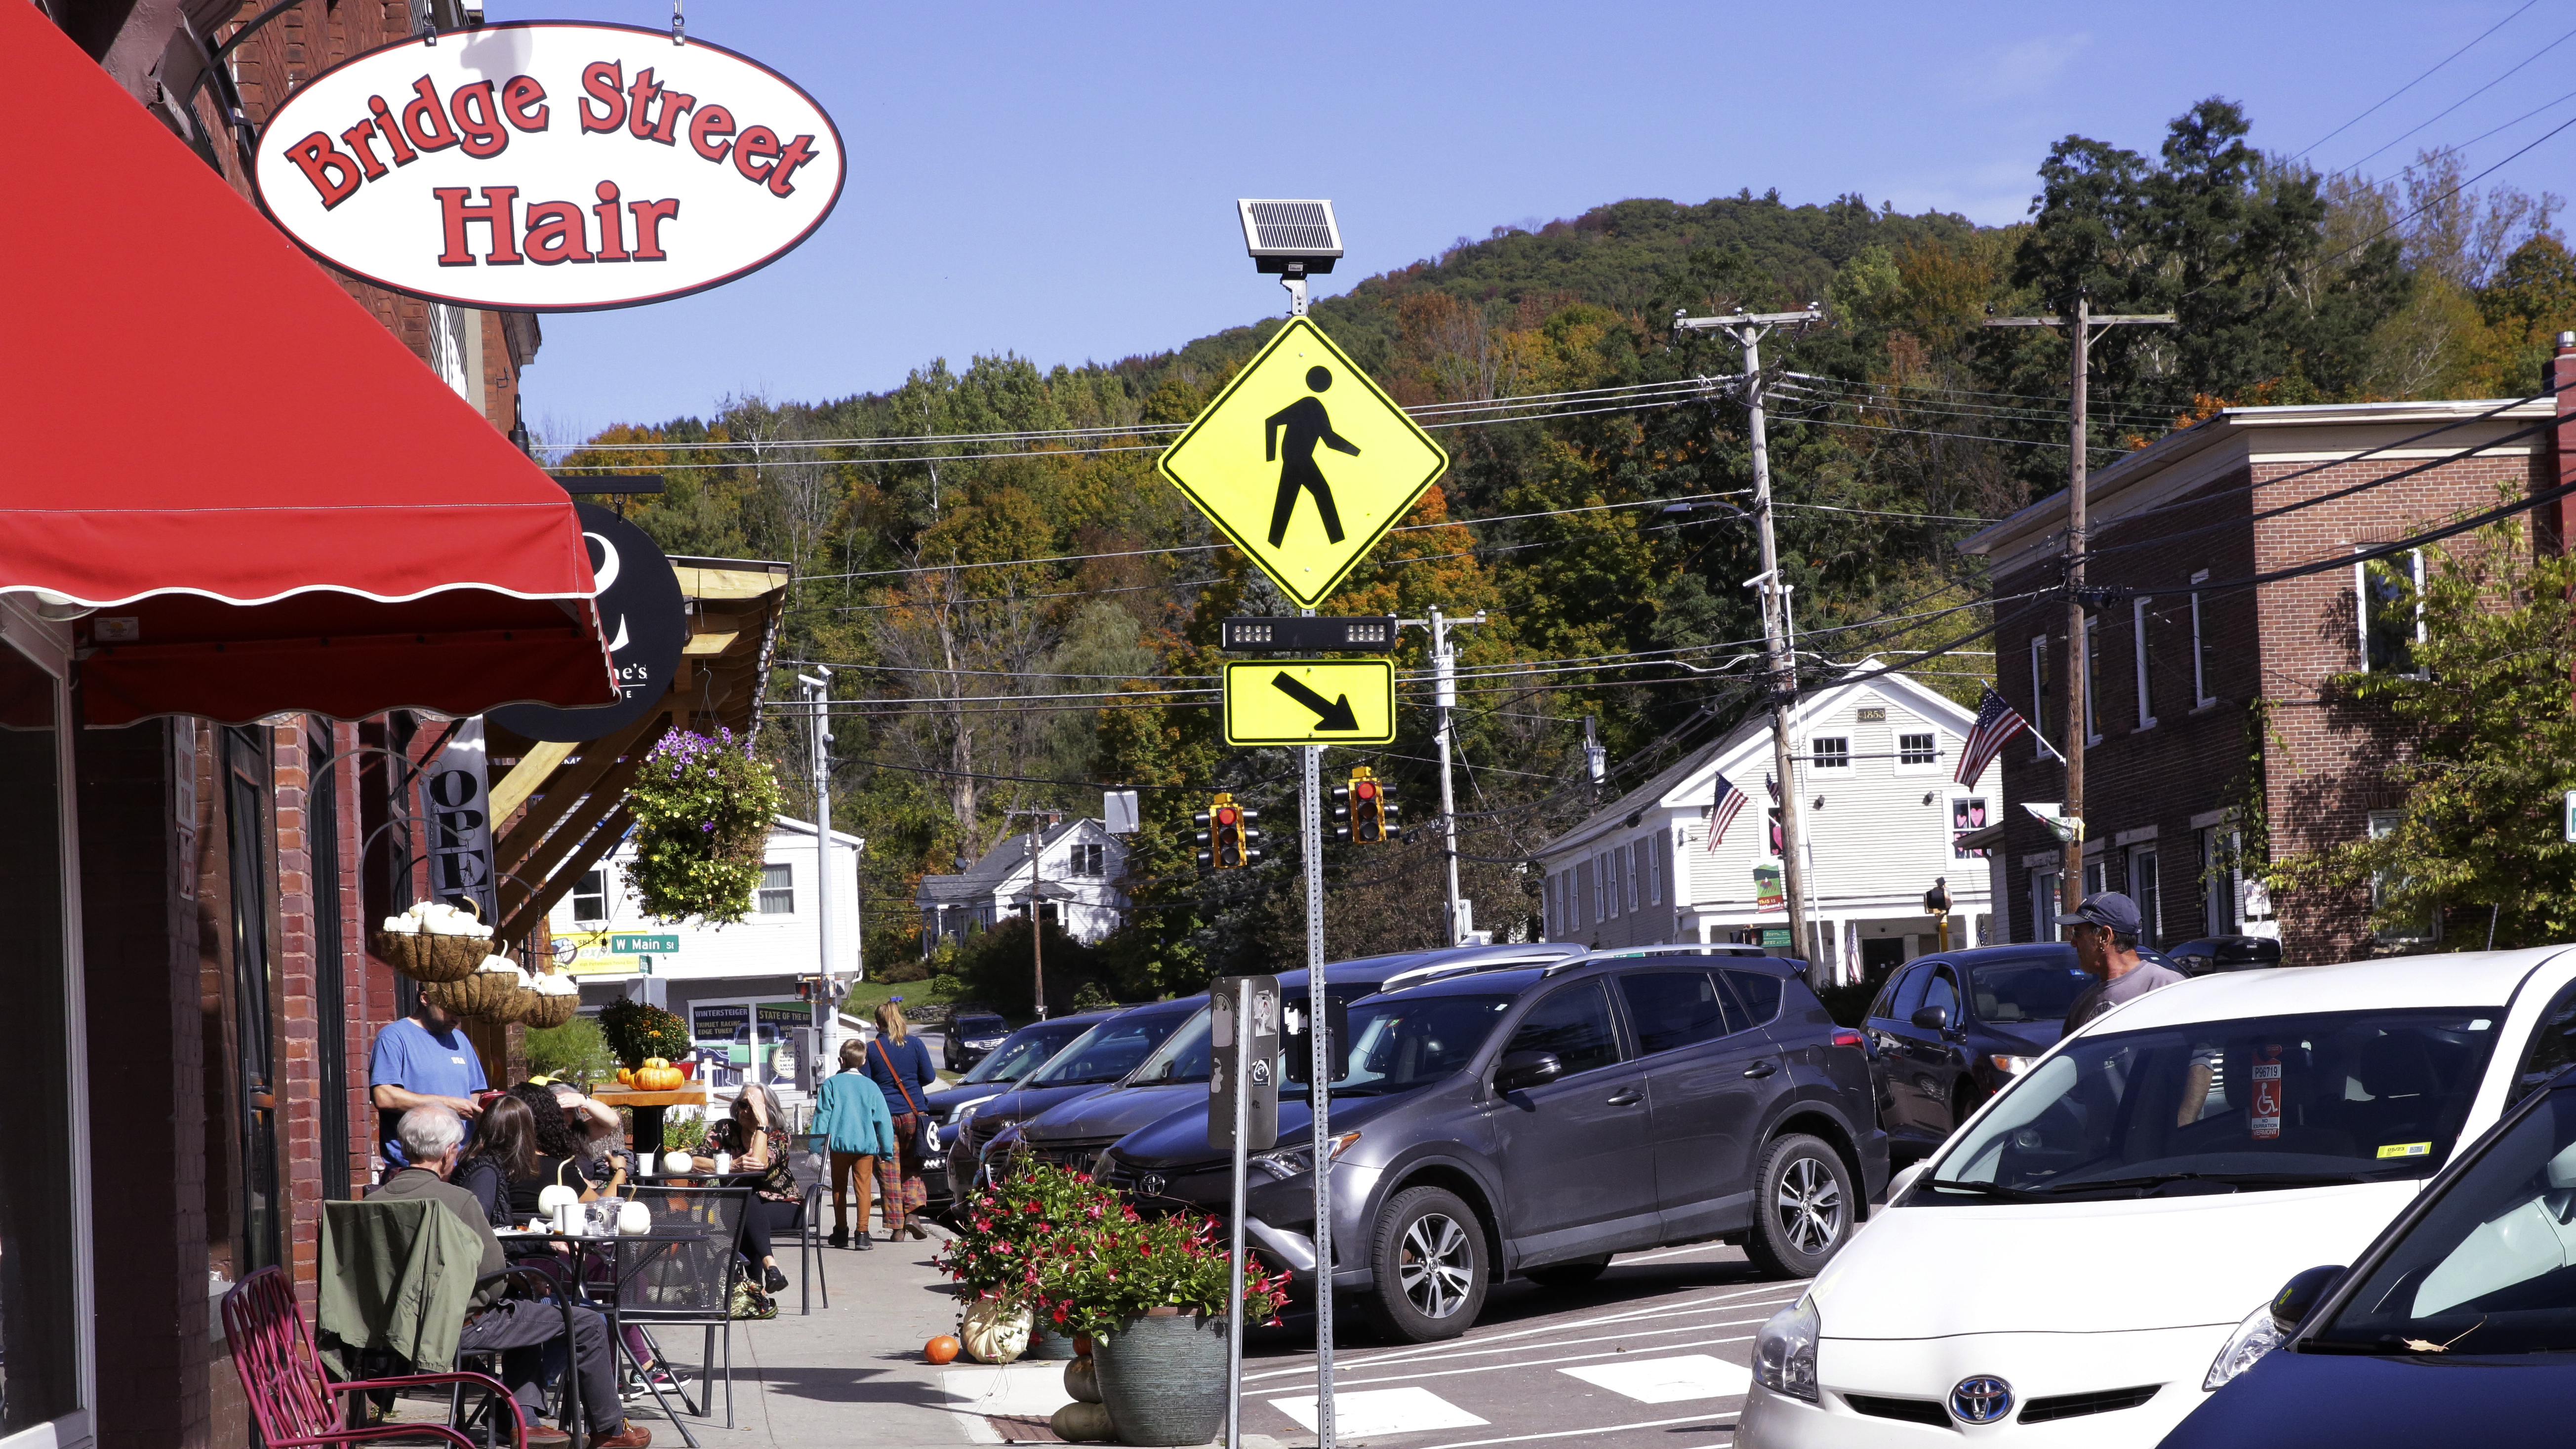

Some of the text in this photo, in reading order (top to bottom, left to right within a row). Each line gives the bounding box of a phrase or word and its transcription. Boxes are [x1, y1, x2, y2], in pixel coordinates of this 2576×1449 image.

[283, 58, 820, 211] Bridge Street
[432, 179, 681, 268] Hair
[616, 939, 626, 950] W
[632, 938, 660, 950] Main
[695, 1008, 748, 1017] WINTERSTEIGER
[759, 1010, 780, 1020] STATE
[2255, 1066, 2278, 1078] P96719
